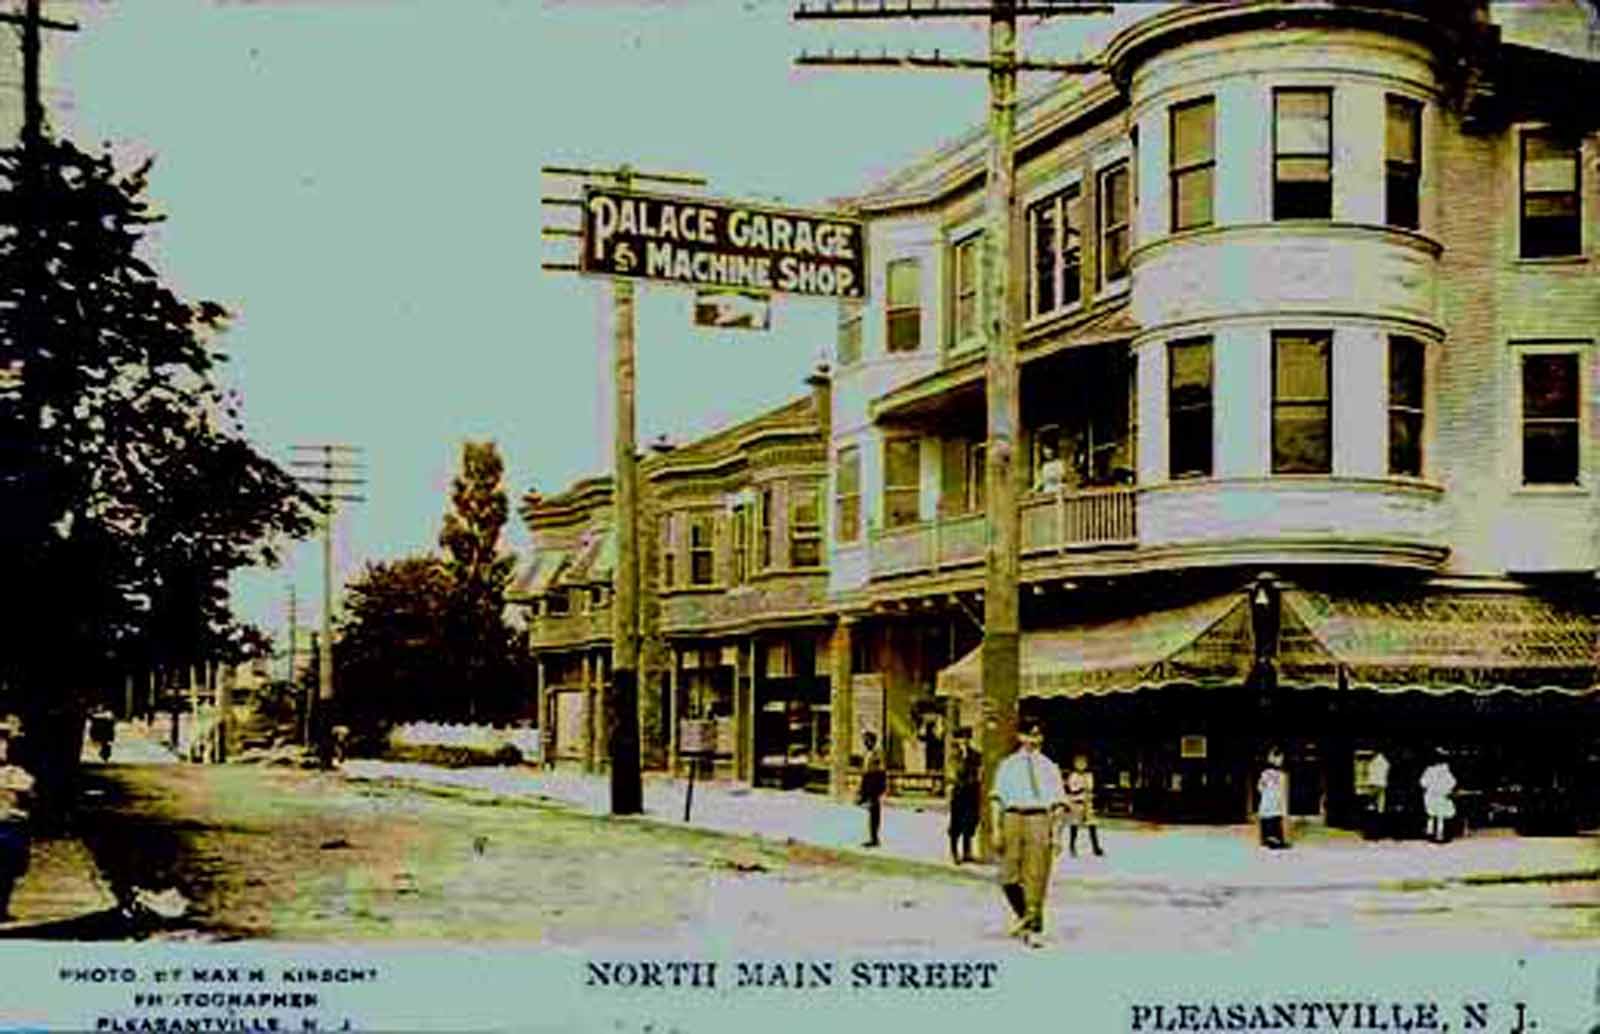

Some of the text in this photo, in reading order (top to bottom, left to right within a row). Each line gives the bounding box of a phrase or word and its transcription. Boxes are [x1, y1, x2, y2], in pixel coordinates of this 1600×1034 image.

[591, 197, 853, 259] PALACE GARAGE
[646, 242, 773, 286] MACHINE
[778, 258, 859, 296] SHOP.
